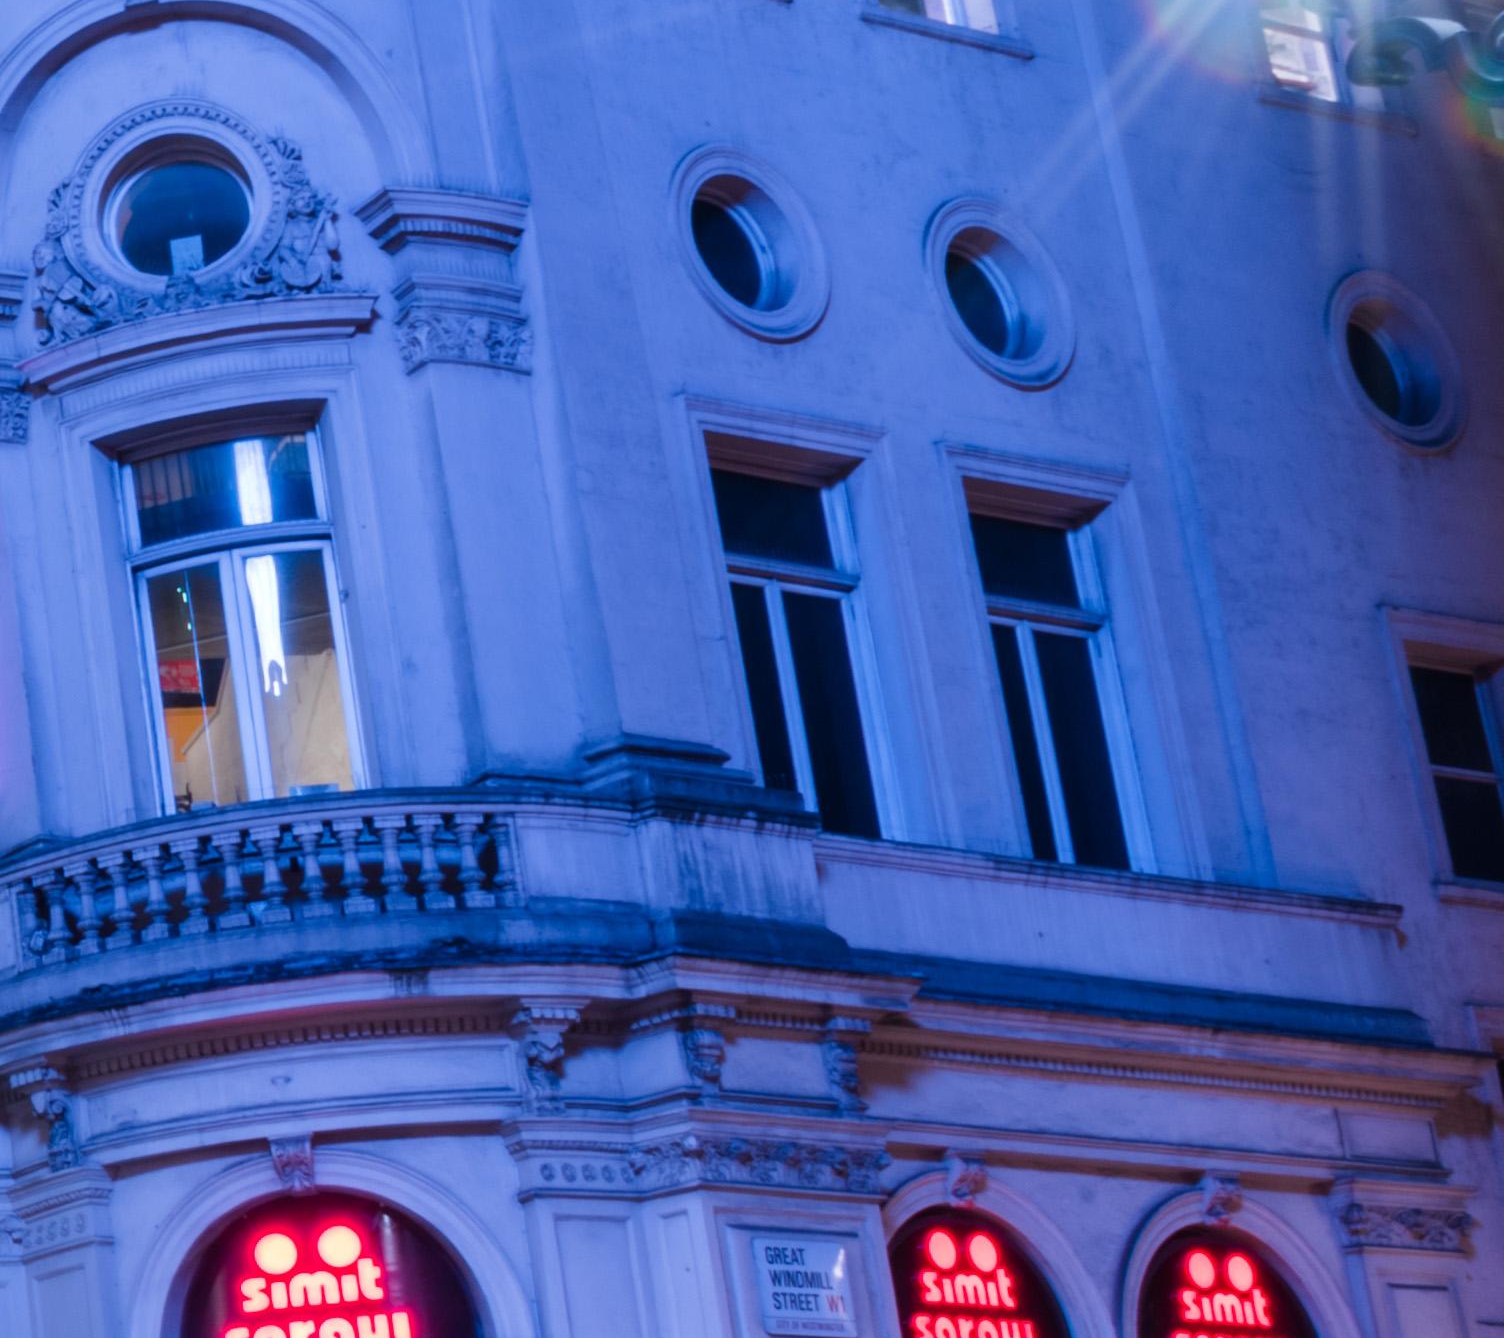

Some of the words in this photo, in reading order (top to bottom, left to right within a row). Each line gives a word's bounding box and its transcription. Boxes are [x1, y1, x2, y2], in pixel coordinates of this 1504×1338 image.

[765, 1246, 805, 1266] GREAT
[240, 1225, 384, 1313] simit
[768, 1269, 833, 1290] WINDMILL
[772, 1292, 820, 1311] STREET
[826, 1294, 845, 1313] W1
